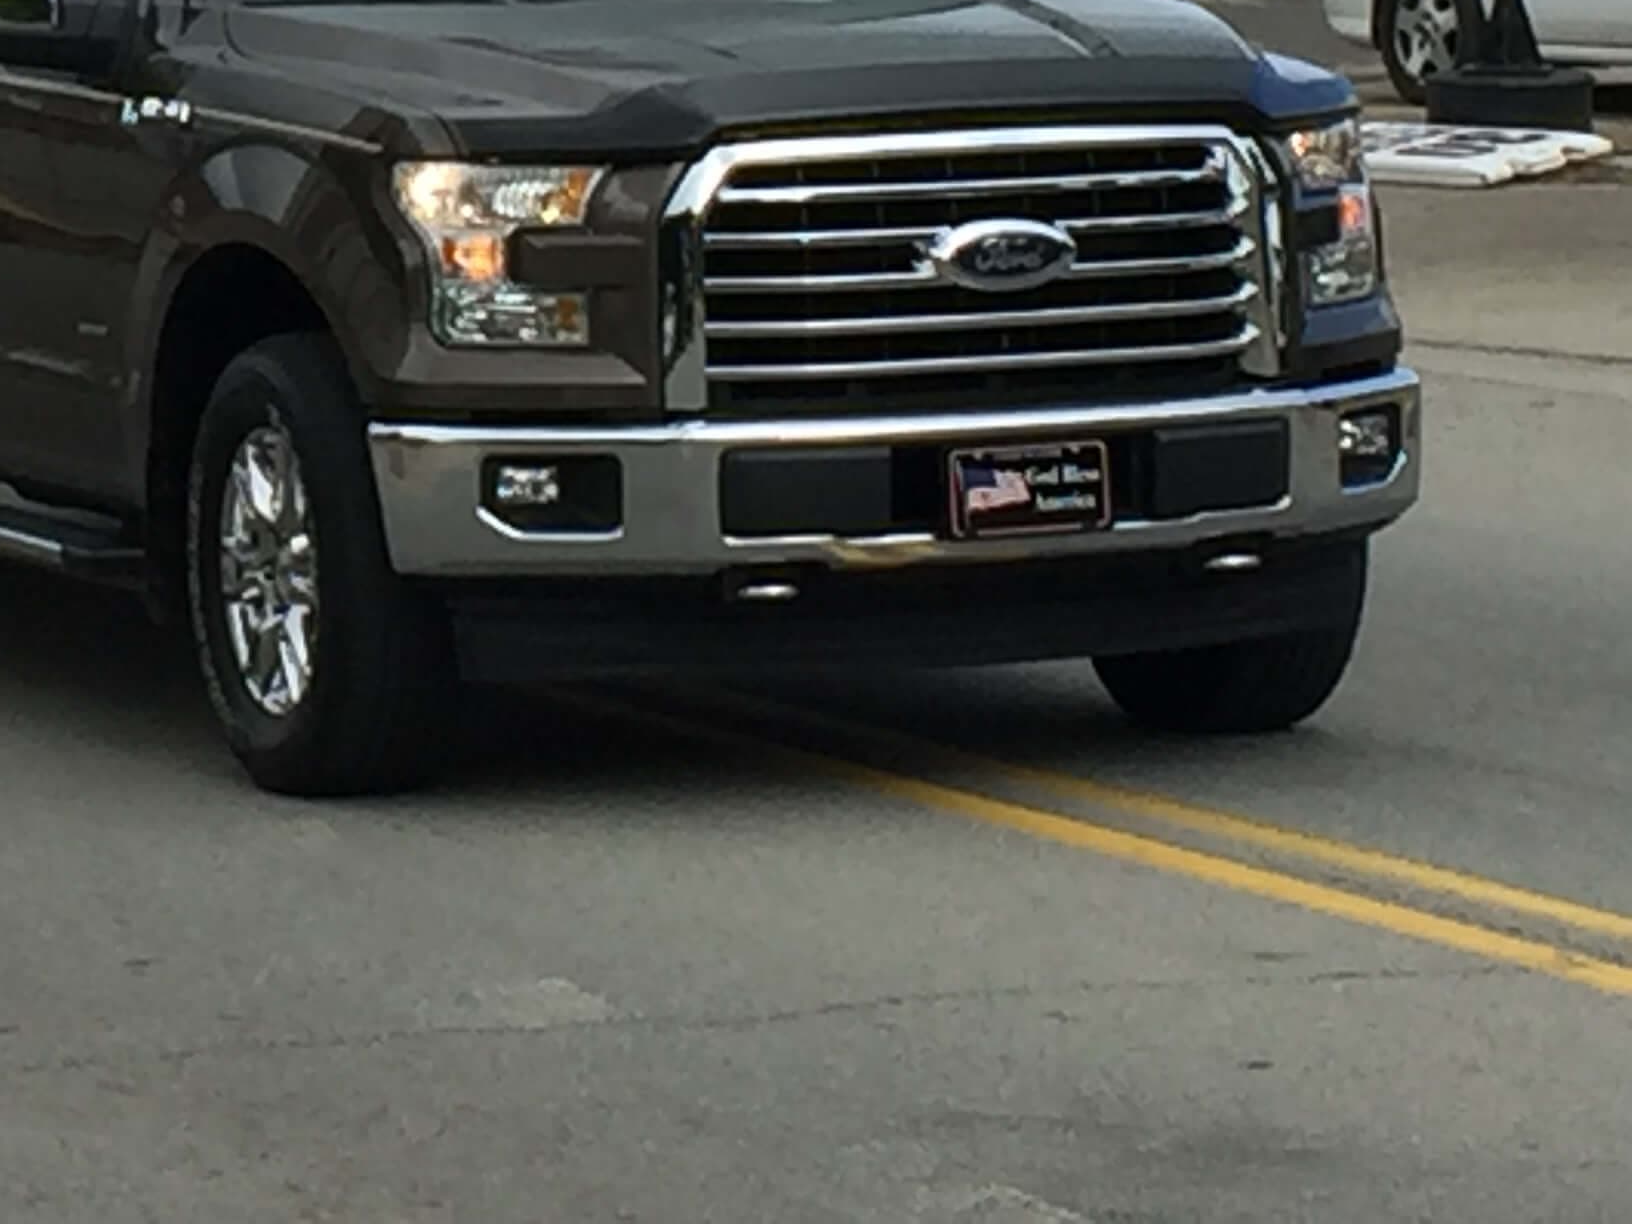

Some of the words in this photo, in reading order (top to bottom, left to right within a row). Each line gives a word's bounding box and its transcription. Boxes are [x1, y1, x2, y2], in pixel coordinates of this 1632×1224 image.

[974, 238, 1043, 272] Ford
[1024, 464, 1059, 485] God
[1062, 463, 1100, 483] Bless
